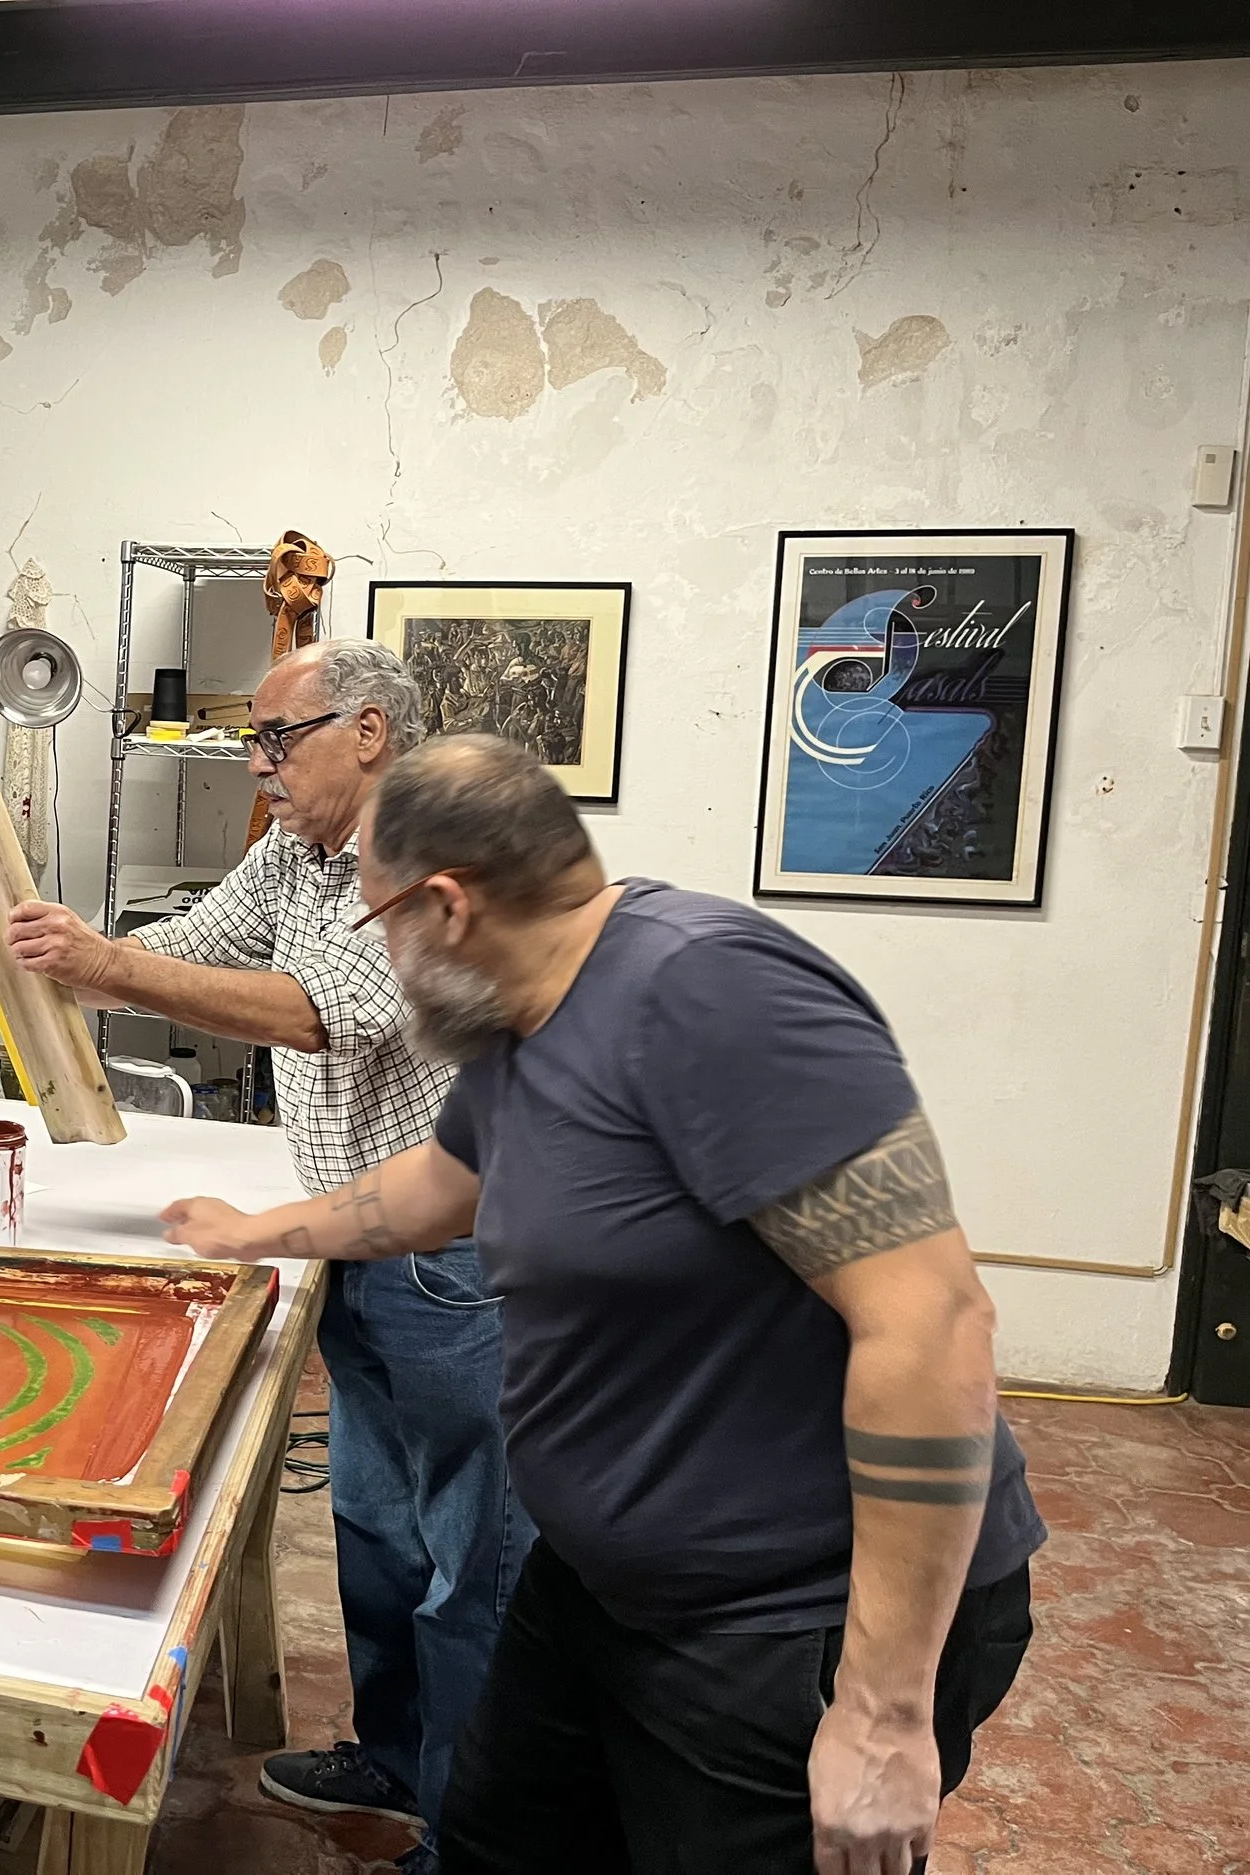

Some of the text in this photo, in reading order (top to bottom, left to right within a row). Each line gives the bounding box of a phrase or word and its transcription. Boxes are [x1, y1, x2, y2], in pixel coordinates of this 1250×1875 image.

[844, 567, 866, 575] Bellas
[867, 567, 888, 575] Artes
[917, 567, 927, 575] de
[927, 567, 947, 576] junio
[947, 567, 957, 575] de
